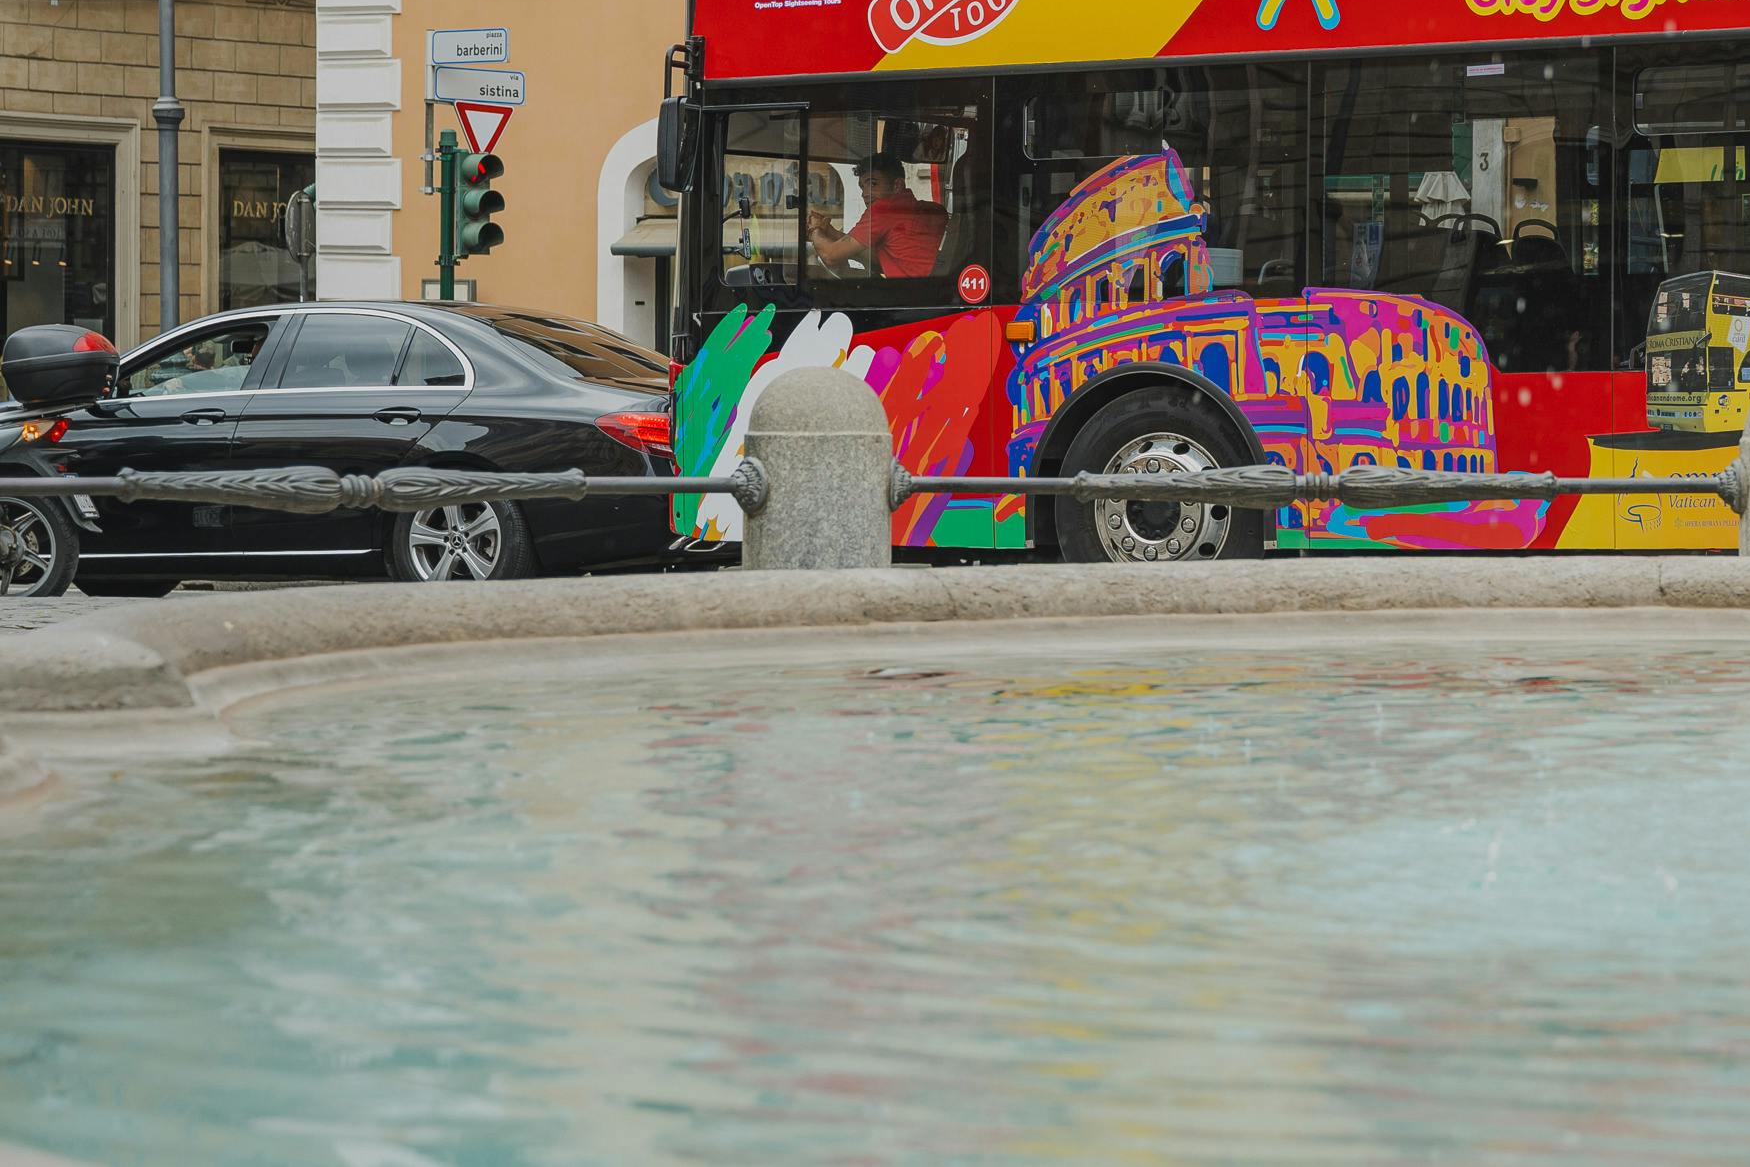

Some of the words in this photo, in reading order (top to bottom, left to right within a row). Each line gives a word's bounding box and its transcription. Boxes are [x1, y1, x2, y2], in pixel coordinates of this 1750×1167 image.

[784, 0, 822, 8] Sightseeing
[457, 44, 502, 56] barberini
[480, 85, 519, 98] sistina
[1480, 153, 1489, 171] 3
[7, 195, 43, 213] DAN
[46, 197, 94, 218] JOHN
[233, 200, 268, 218] DAN
[962, 277, 985, 290] 411
[1669, 494, 1716, 508] Vatican
